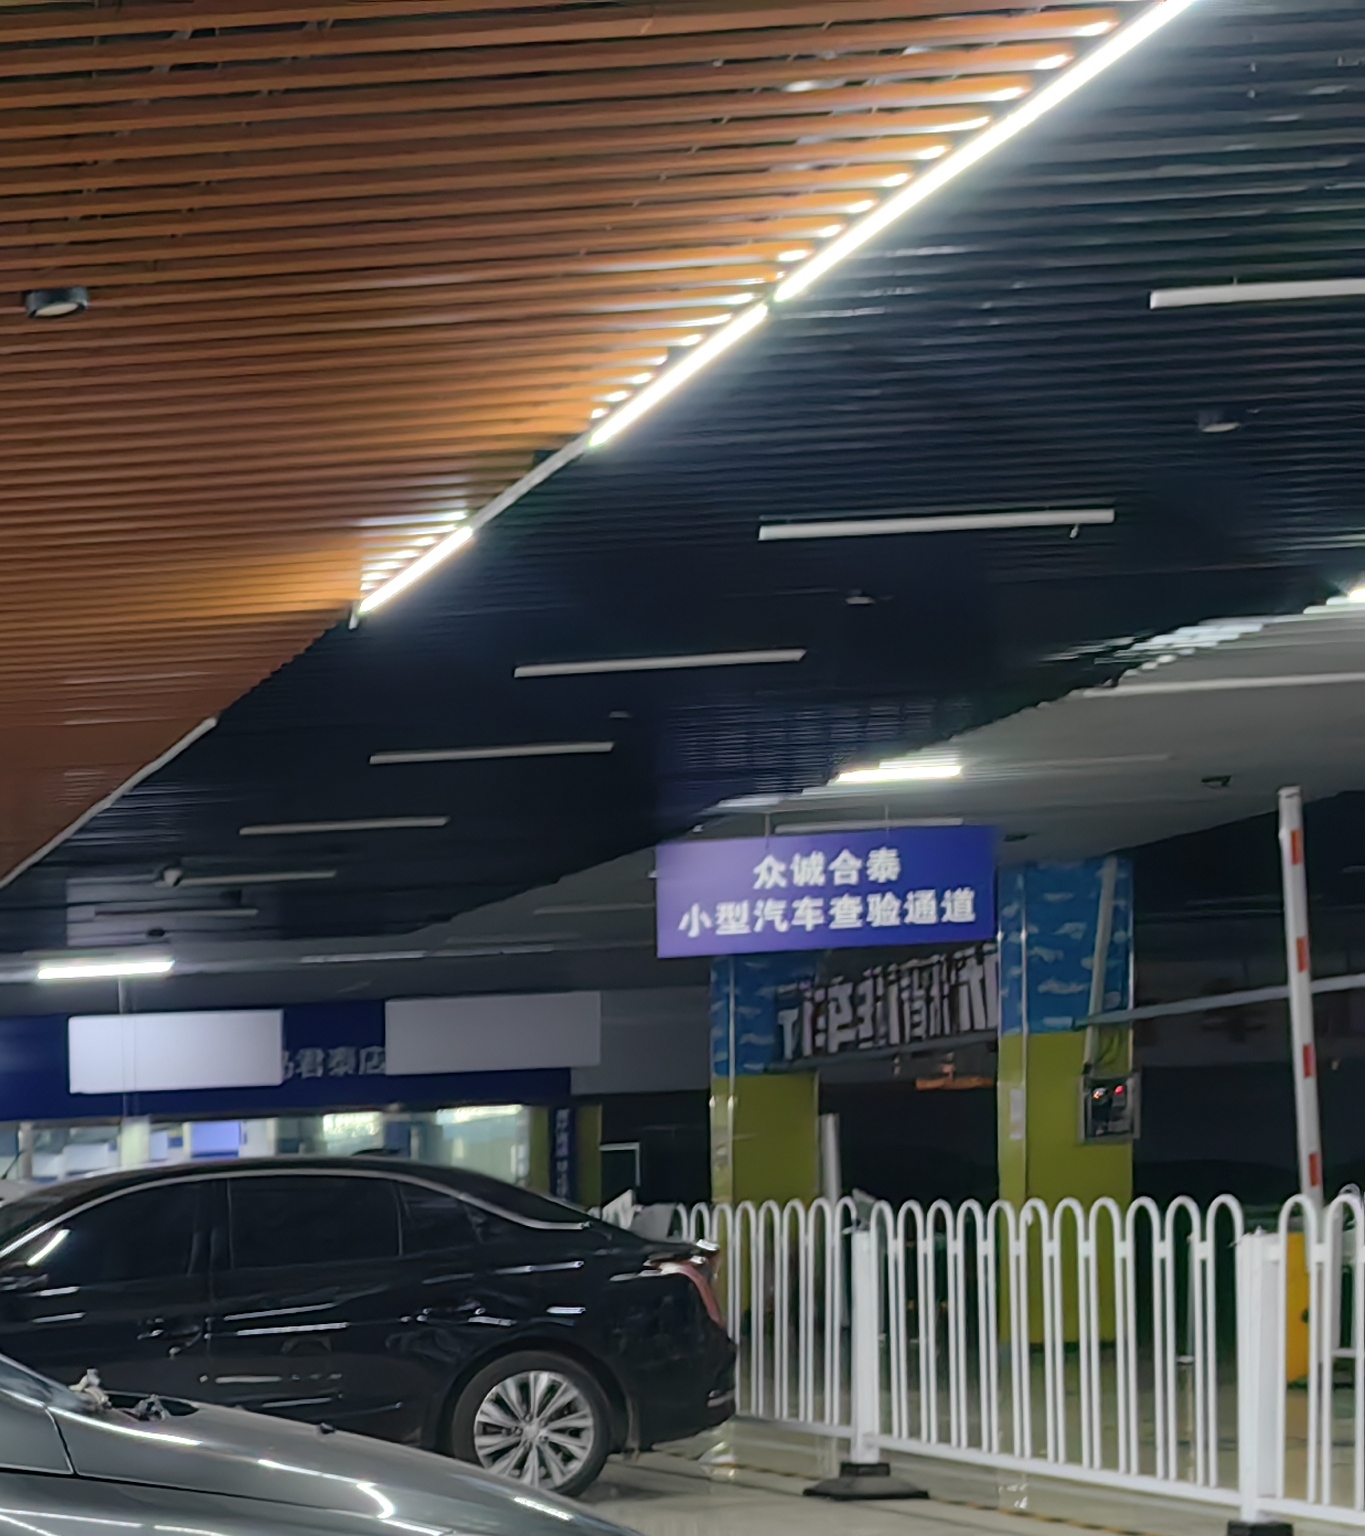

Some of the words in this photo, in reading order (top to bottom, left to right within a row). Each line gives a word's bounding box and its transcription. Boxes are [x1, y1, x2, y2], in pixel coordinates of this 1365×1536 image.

[753, 848, 901, 889] 众诚合泰
[678, 886, 976, 938] 小型汽车查验通道
